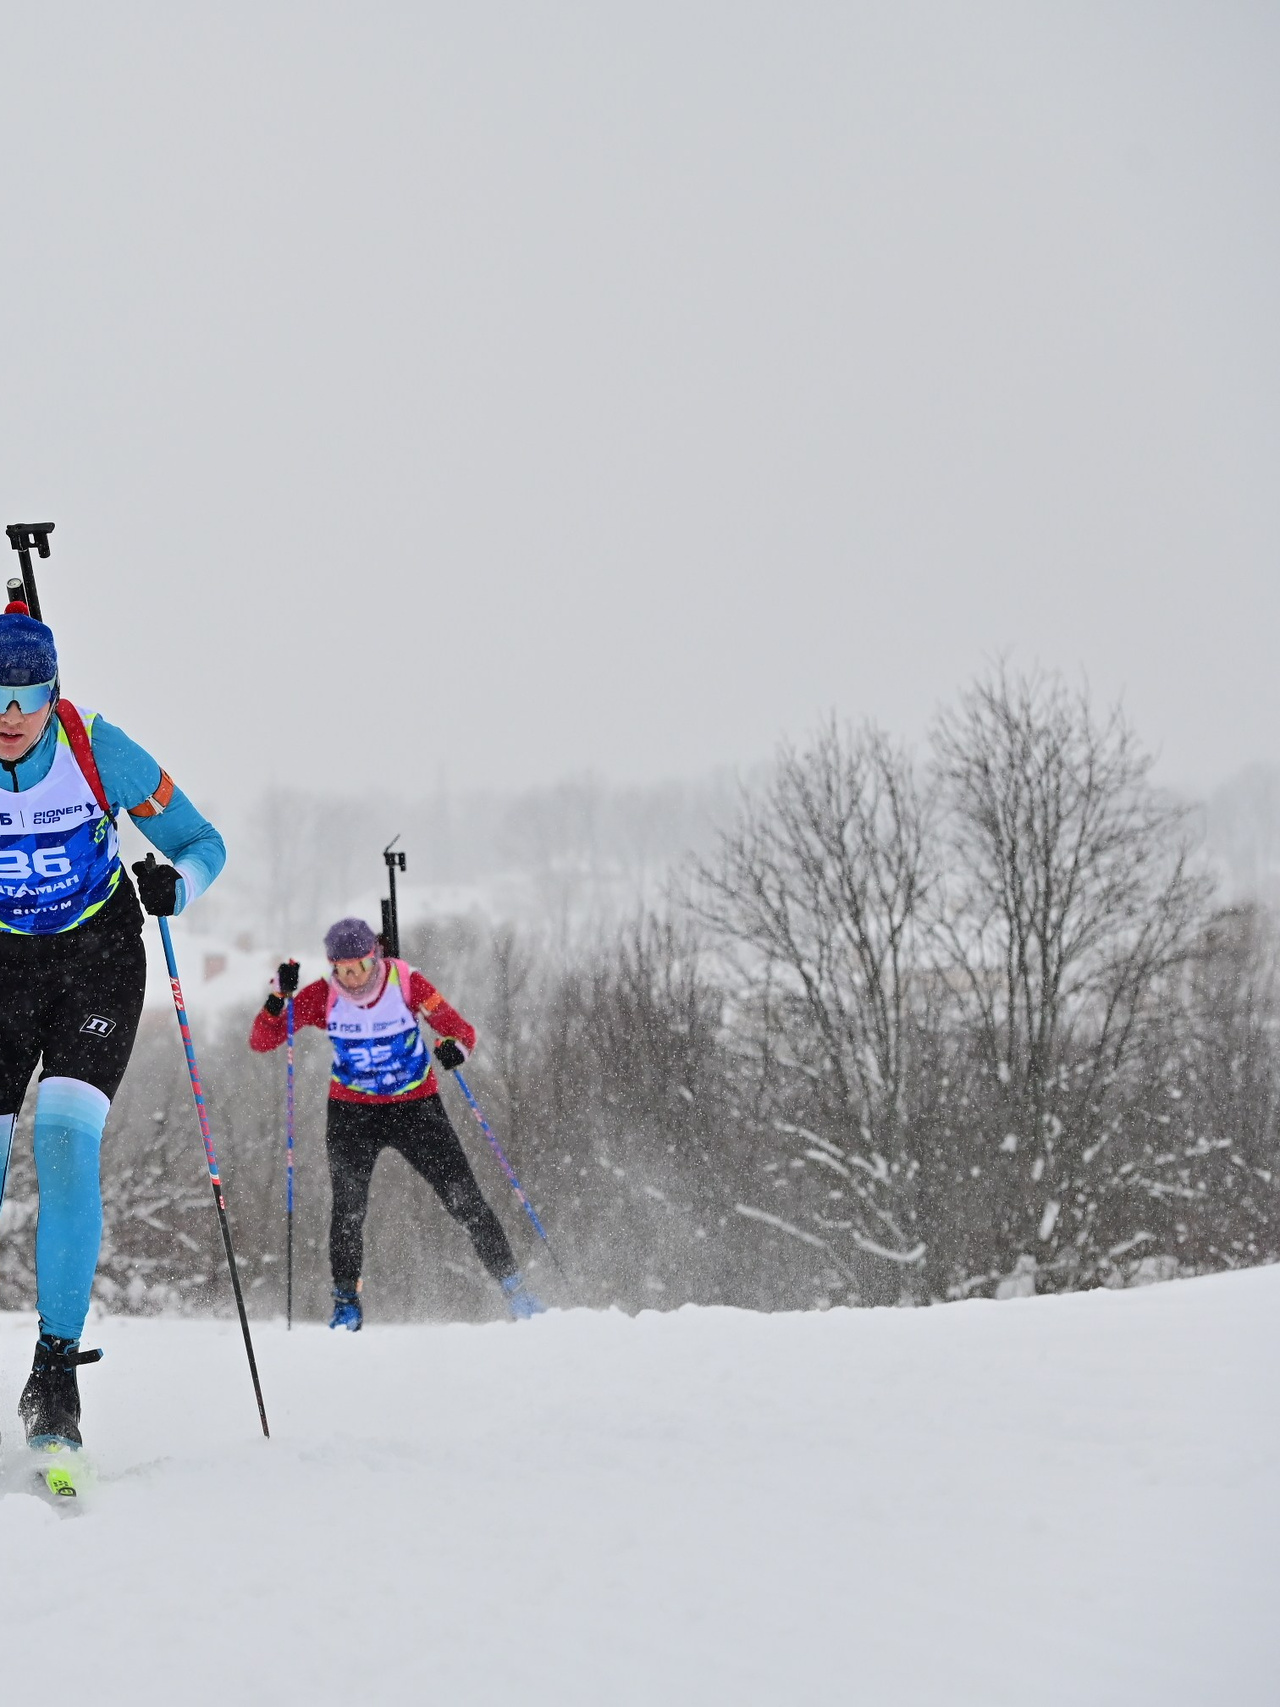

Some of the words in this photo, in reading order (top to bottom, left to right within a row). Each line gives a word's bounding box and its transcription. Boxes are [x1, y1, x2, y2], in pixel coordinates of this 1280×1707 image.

[33, 805, 83, 818] PIONER
[33, 817, 61, 825] CUP
[348, 1045, 392, 1070] 35
